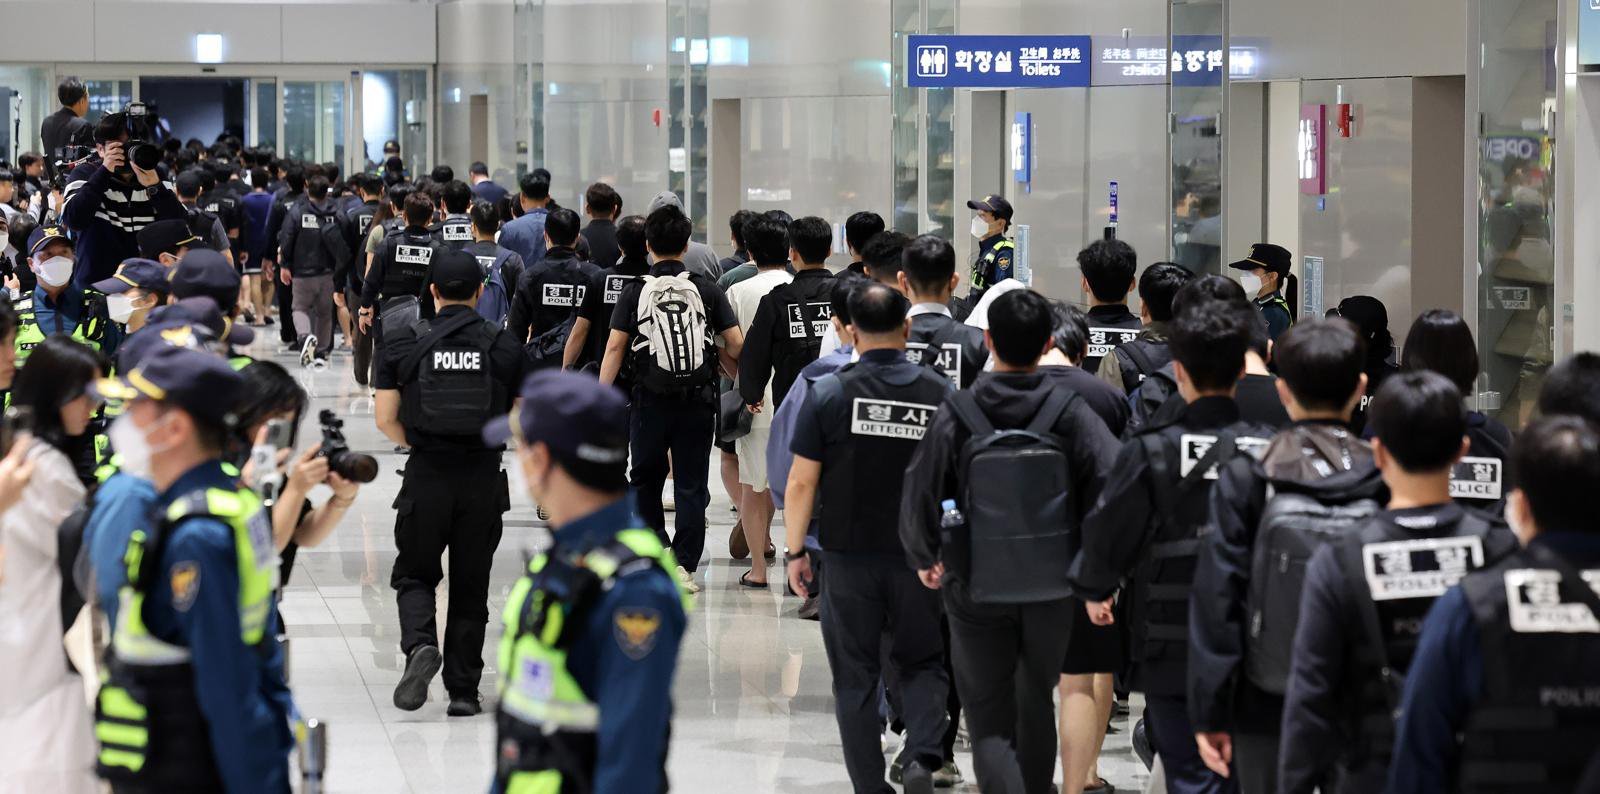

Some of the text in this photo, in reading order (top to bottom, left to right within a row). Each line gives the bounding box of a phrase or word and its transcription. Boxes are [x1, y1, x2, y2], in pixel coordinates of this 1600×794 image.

[954, 50, 1013, 73] 화장실
[1020, 48, 1048, 60] 卫生间
[1052, 48, 1081, 60] お手洗
[1020, 62, 1061, 77] Toilets
[434, 352, 481, 370] POLICE
[866, 404, 929, 426] 형사
[861, 422, 925, 437] DETECTIV
